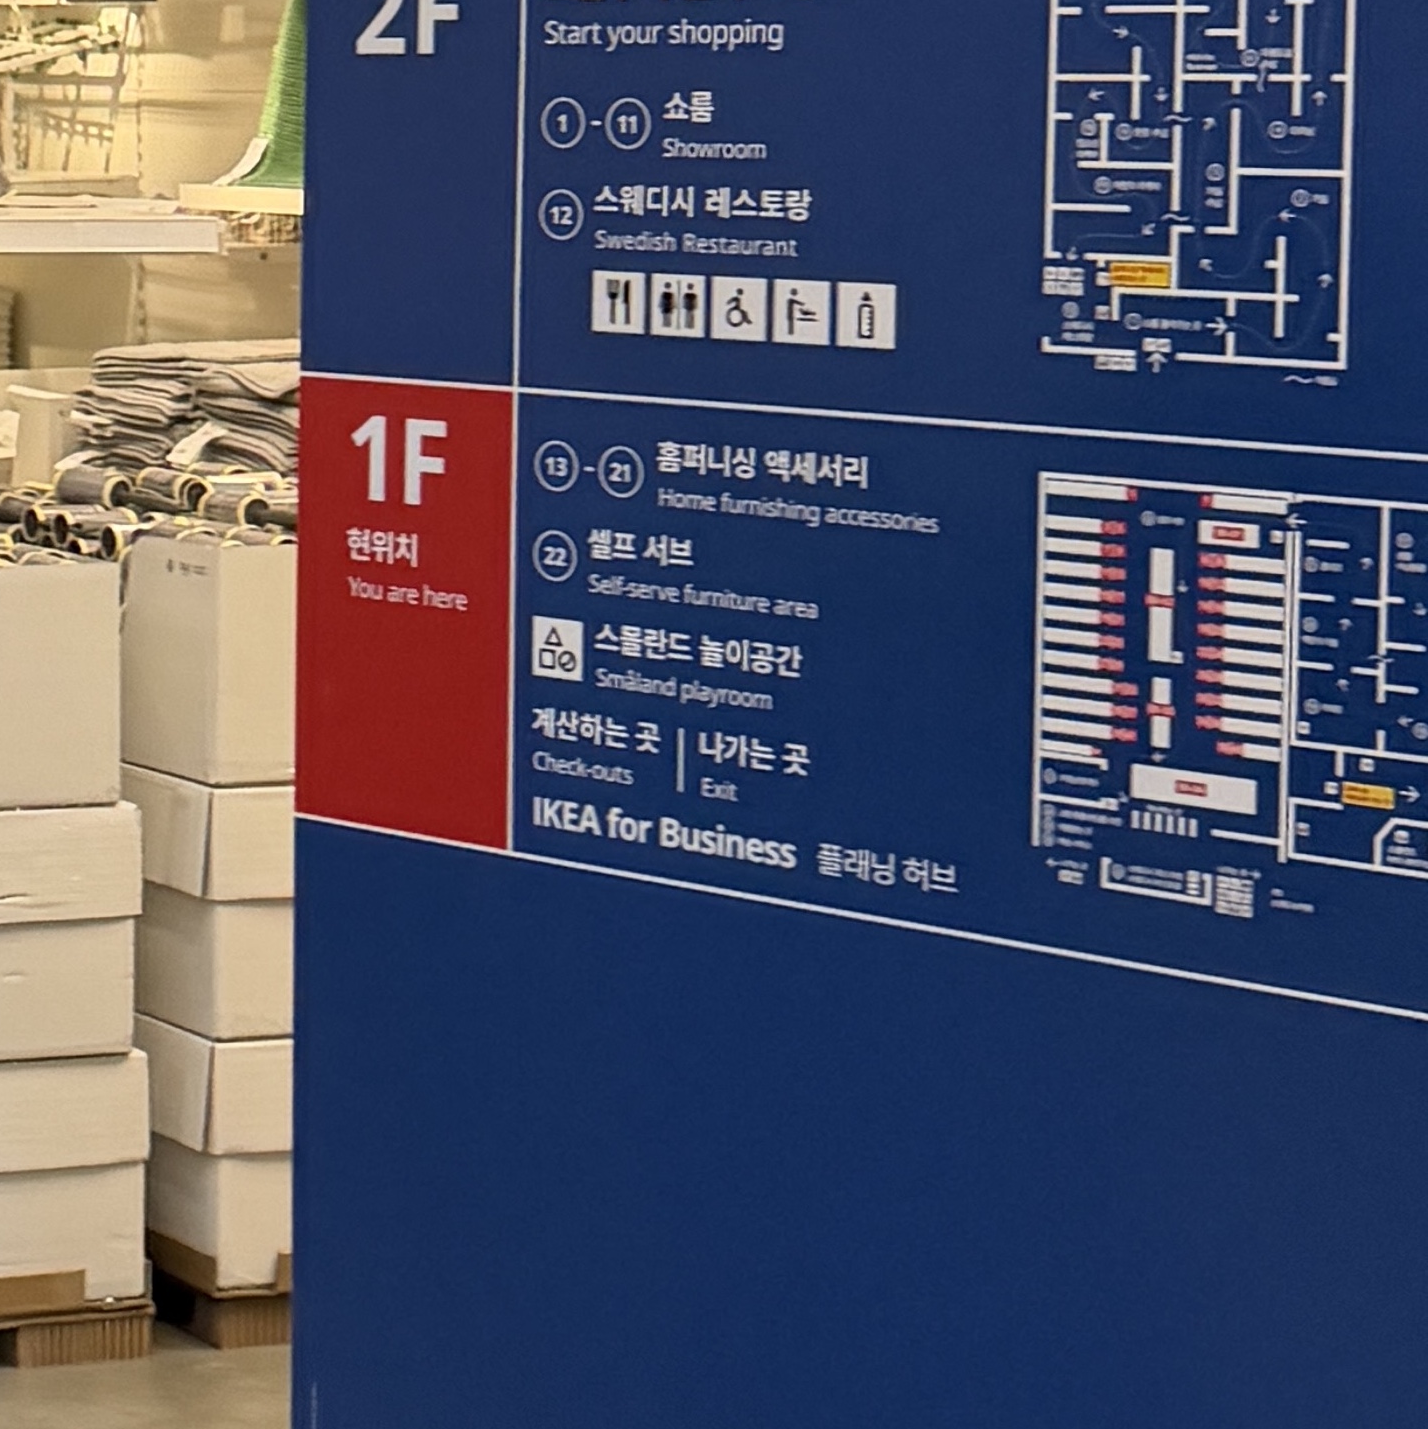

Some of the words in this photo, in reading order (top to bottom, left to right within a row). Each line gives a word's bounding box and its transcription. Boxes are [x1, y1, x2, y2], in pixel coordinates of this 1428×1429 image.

[544, 19, 603, 46] Start
[604, 22, 664, 52] your
[668, 18, 785, 51] shopping
[662, 90, 715, 123] 쇼룸
[661, 136, 768, 160] Showroom
[593, 184, 695, 219] 스웨디시
[704, 187, 813, 222] 레스토랑
[594, 230, 677, 253] Swedish
[682, 232, 799, 257] Restaurant
[351, 415, 448, 506] 1F
[655, 440, 757, 479] 홈퍼니싱
[763, 450, 869, 489] 액세서리
[657, 487, 717, 512] Home
[720, 492, 821, 528] furnishing
[824, 503, 941, 534] accessories
[346, 526, 418, 568] 현위치
[586, 528, 638, 561] 셀프
[642, 534, 695, 567] 서브
[347, 575, 384, 601] You
[386, 584, 420, 606] are
[422, 583, 469, 612] here
[587, 573, 681, 604] Self-serve
[683, 582, 771, 615] furniture
[772, 596, 820, 621] area
[697, 634, 804, 679] 놀이공간
[679, 679, 774, 711] playroom
[531, 706, 631, 749] 계산하는
[635, 721, 661, 755] 곳
[531, 750, 635, 786] Check-outs
[697, 730, 777, 772] 나가는
[782, 742, 811, 776] 곳
[700, 776, 739, 803] Exit
[532, 795, 602, 837] IKEA
[606, 807, 653, 844] for
[658, 816, 798, 870] Business
[815, 842, 897, 886] 플래닝
[901, 858, 960, 893] 허브
